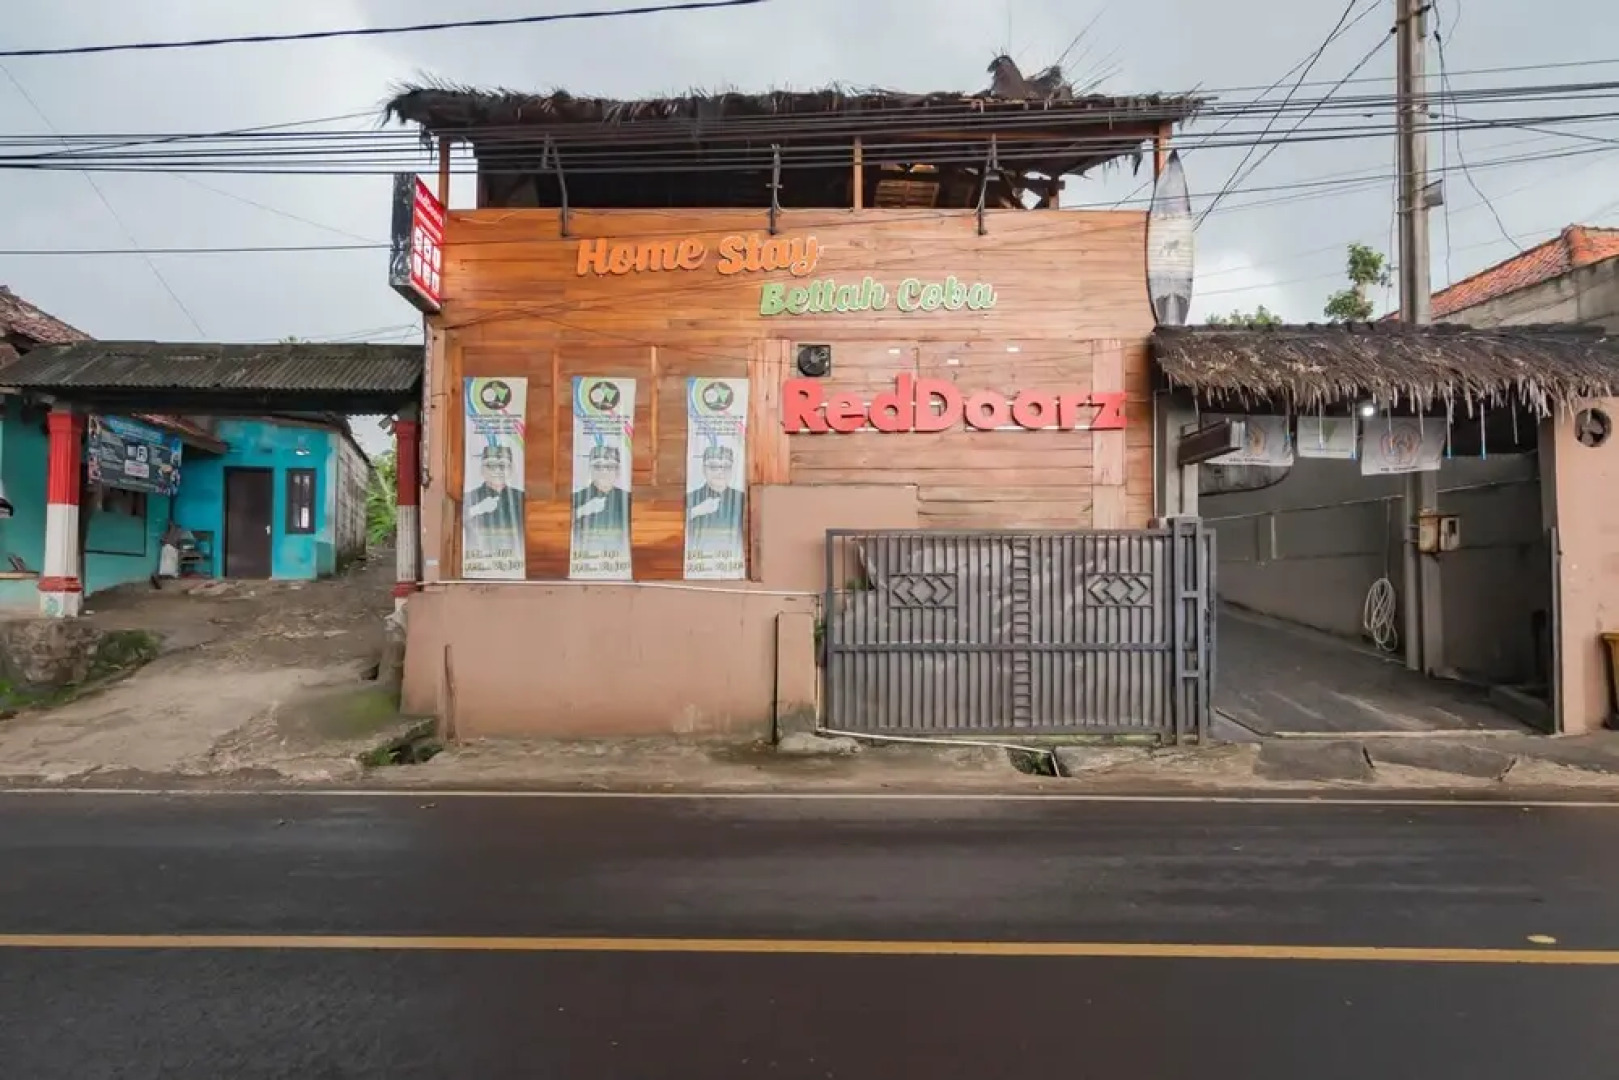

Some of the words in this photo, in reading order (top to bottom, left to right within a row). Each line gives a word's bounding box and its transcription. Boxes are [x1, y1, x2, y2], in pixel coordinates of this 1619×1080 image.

[577, 236, 706, 277] Home
[716, 234, 825, 277] Stay
[760, 276, 890, 315] Bettah
[896, 275, 998, 313] Coba
[783, 373, 1127, 434] RedDoorz
